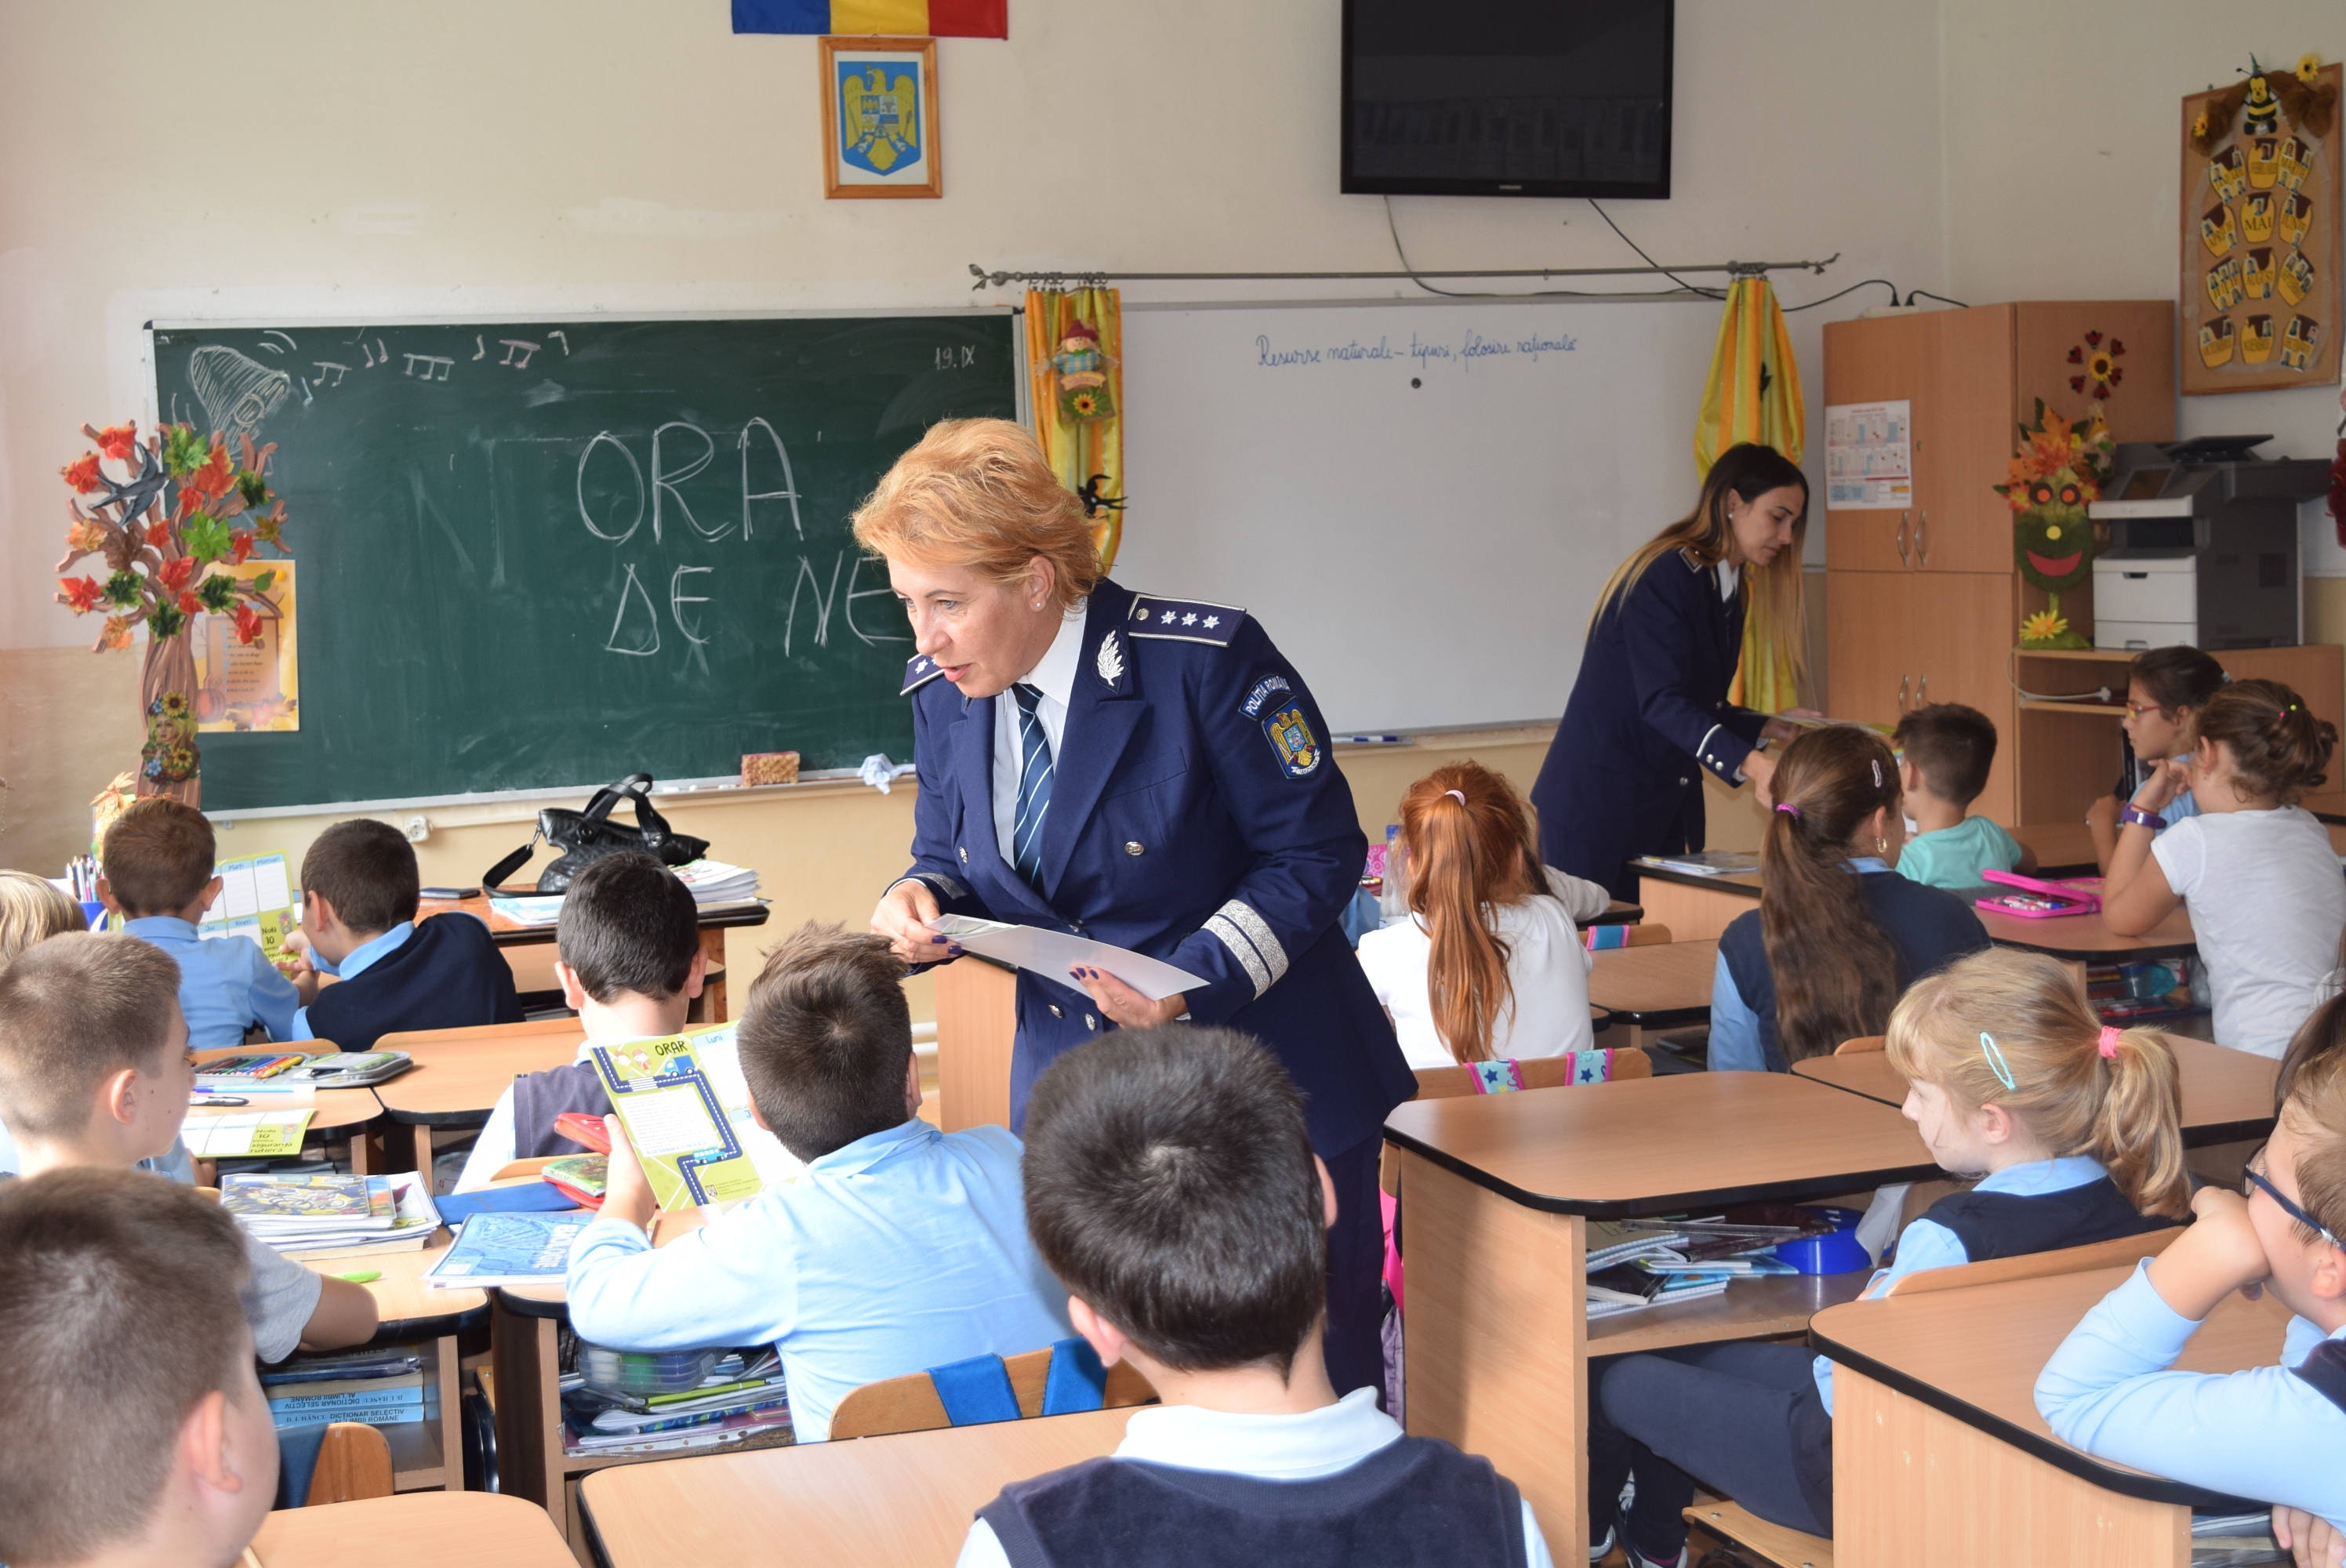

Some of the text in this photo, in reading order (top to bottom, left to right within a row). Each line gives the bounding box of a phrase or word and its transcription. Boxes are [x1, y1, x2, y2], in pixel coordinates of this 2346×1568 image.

[2244, 216, 2272, 231] MAI
[1255, 335, 1321, 366] Resurse
[1462, 328, 1510, 373] folosire
[577, 416, 804, 546] ORA
[600, 550, 914, 657] DE NE
[256, 855, 280, 865] Miercuri
[266, 935, 274, 944] 10
[705, 1033, 723, 1044] Luni
[655, 1040, 688, 1056] ORAR
[532, 1224, 579, 1269] BIOLOGIE
[285, 1399, 320, 1409] SELECTIV
[322, 1393, 346, 1402] LIMBII
